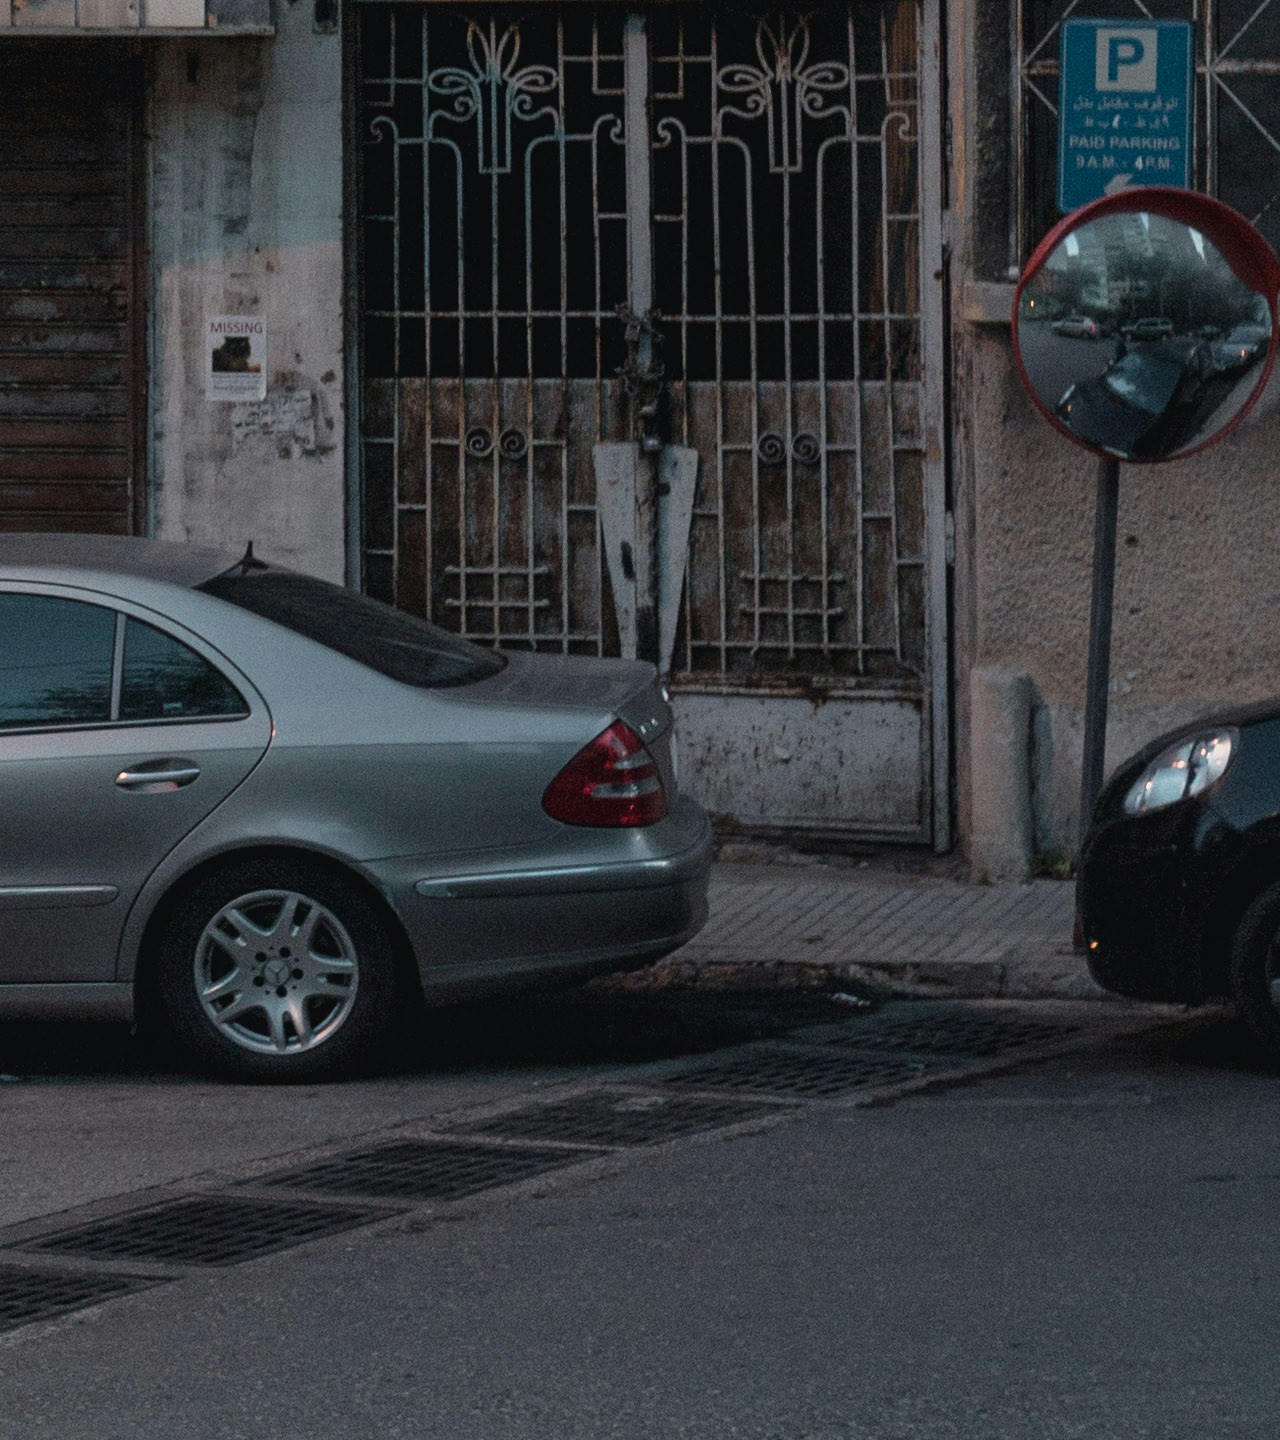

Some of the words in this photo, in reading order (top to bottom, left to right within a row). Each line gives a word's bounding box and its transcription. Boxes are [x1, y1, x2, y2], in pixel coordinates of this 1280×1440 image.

[1108, 37, 1144, 81] P
[1068, 134, 1105, 150] PAID
[1109, 135, 1181, 151] PARKING
[209, 322, 263, 334] MISSING
